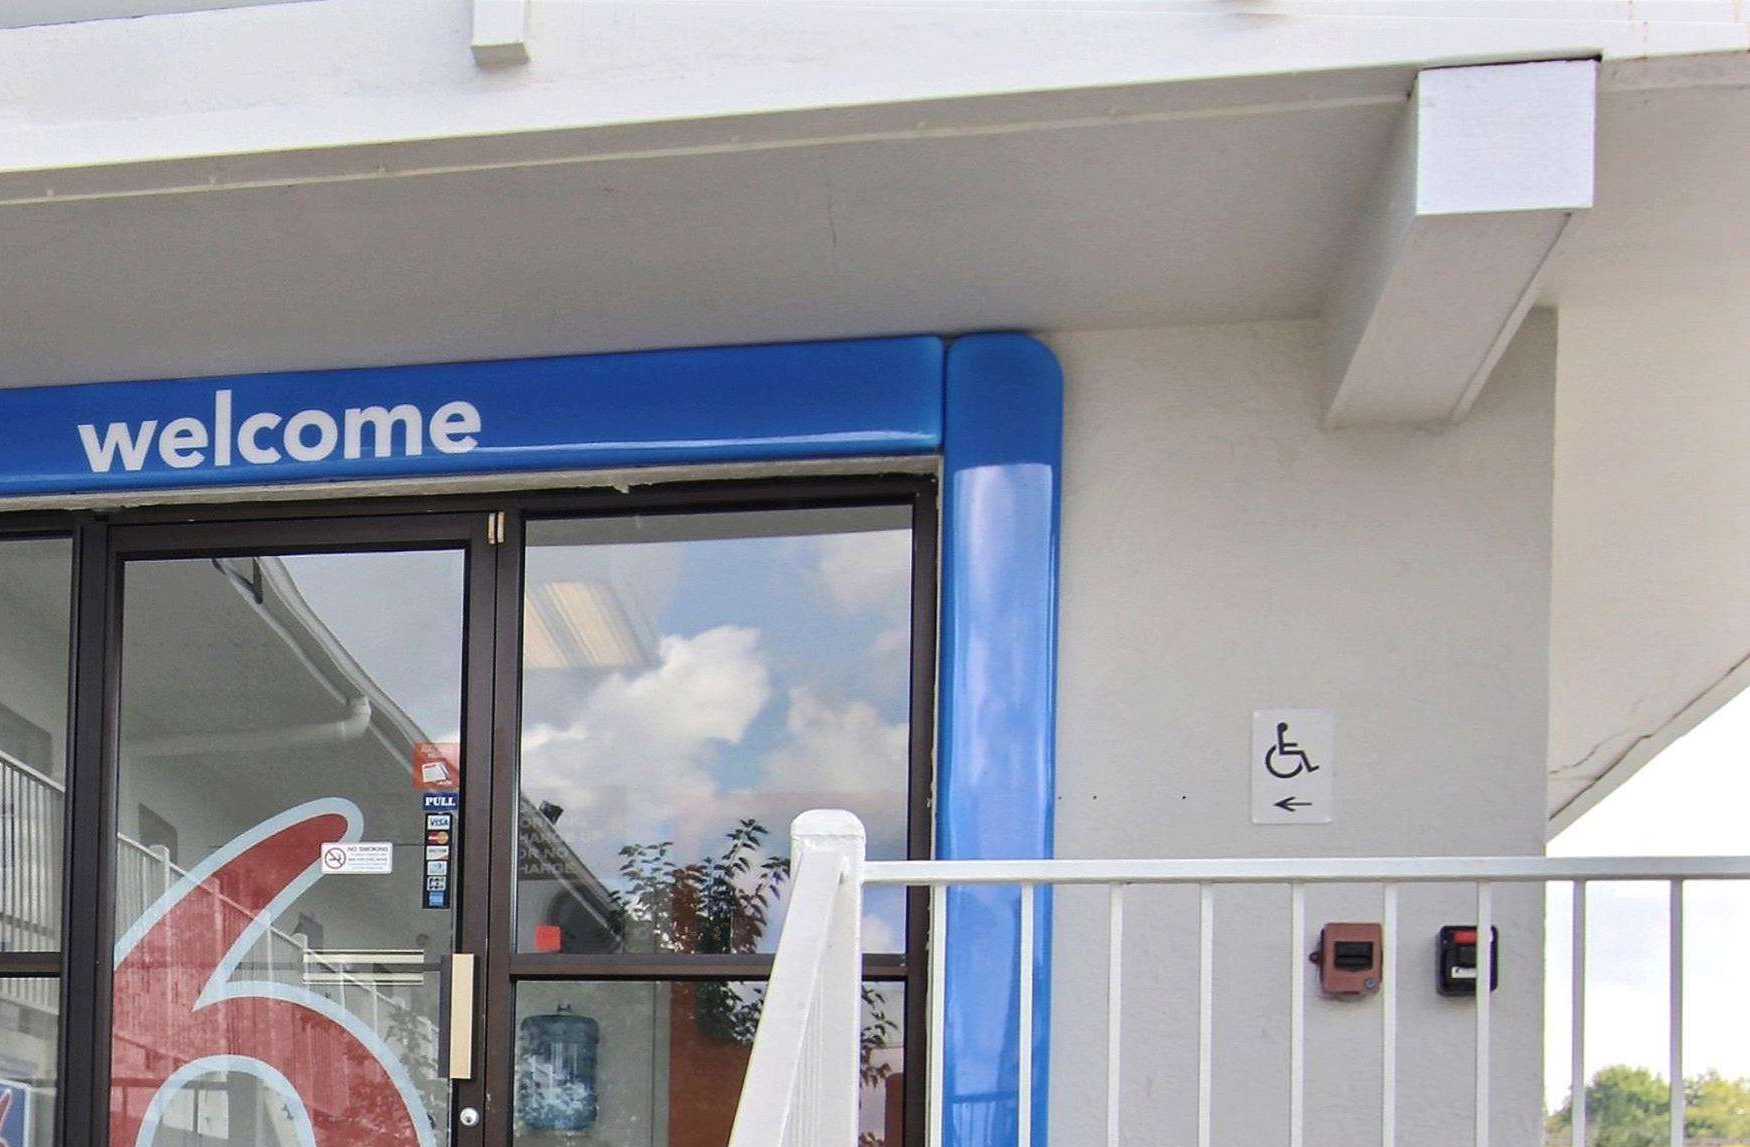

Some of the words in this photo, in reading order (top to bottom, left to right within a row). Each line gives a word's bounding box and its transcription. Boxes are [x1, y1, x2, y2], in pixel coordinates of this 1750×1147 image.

[77, 389, 482, 473] welcome
[425, 797, 456, 806] PULL
[431, 818, 448, 826] VISA
